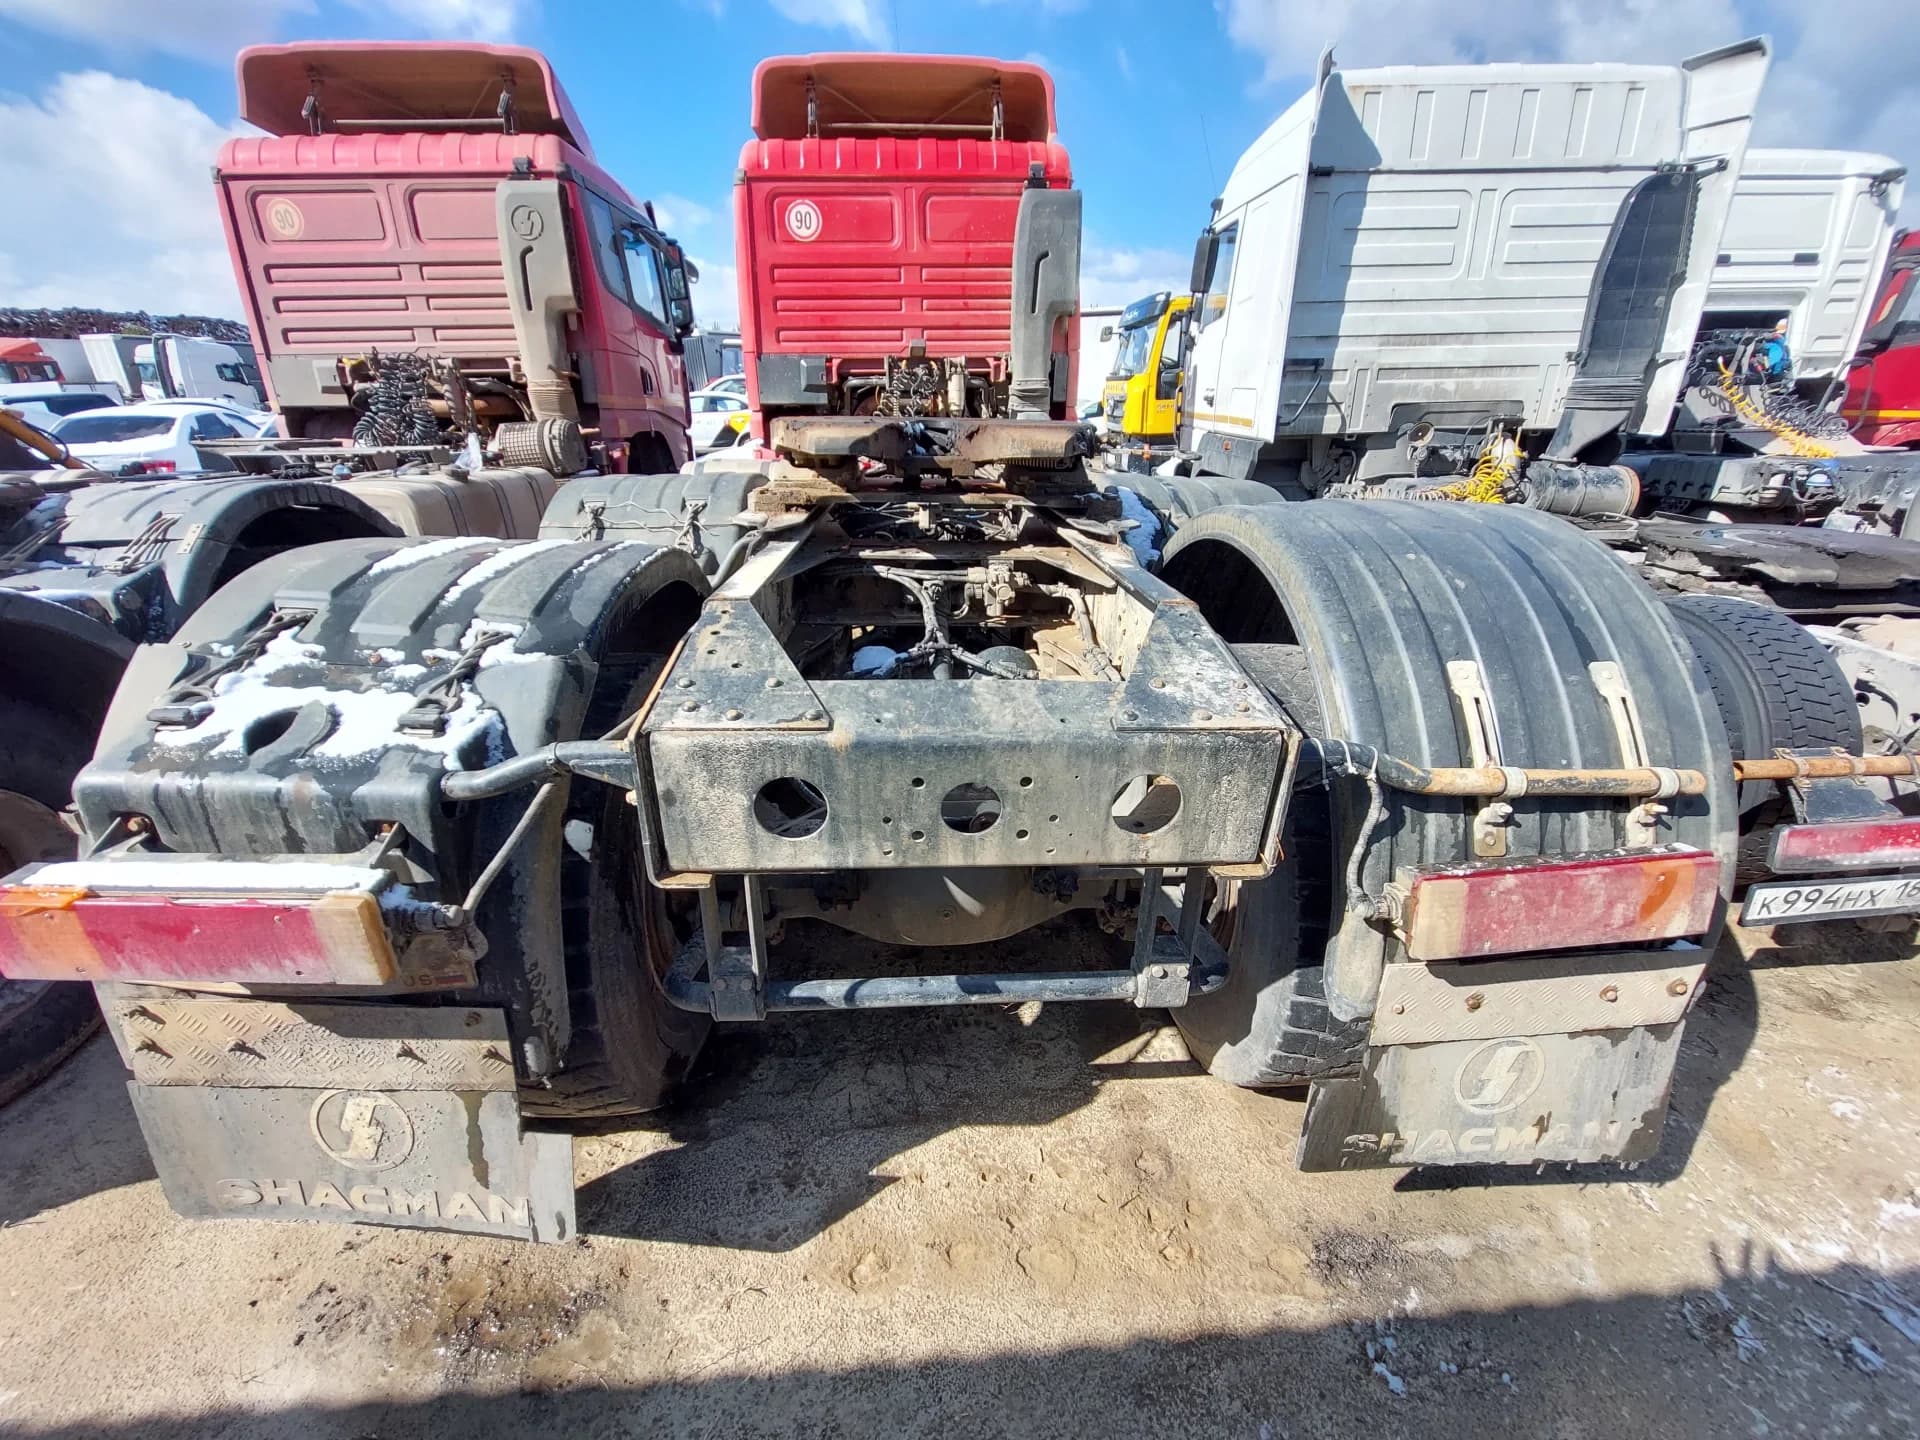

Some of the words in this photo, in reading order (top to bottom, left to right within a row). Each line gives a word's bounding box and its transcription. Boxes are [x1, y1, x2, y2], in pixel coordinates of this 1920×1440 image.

[274, 207, 296, 230] 90
[795, 210, 812, 230] 90
[1342, 1119, 1624, 1154] SHACMAN
[217, 1177, 530, 1228] SHACMAN
